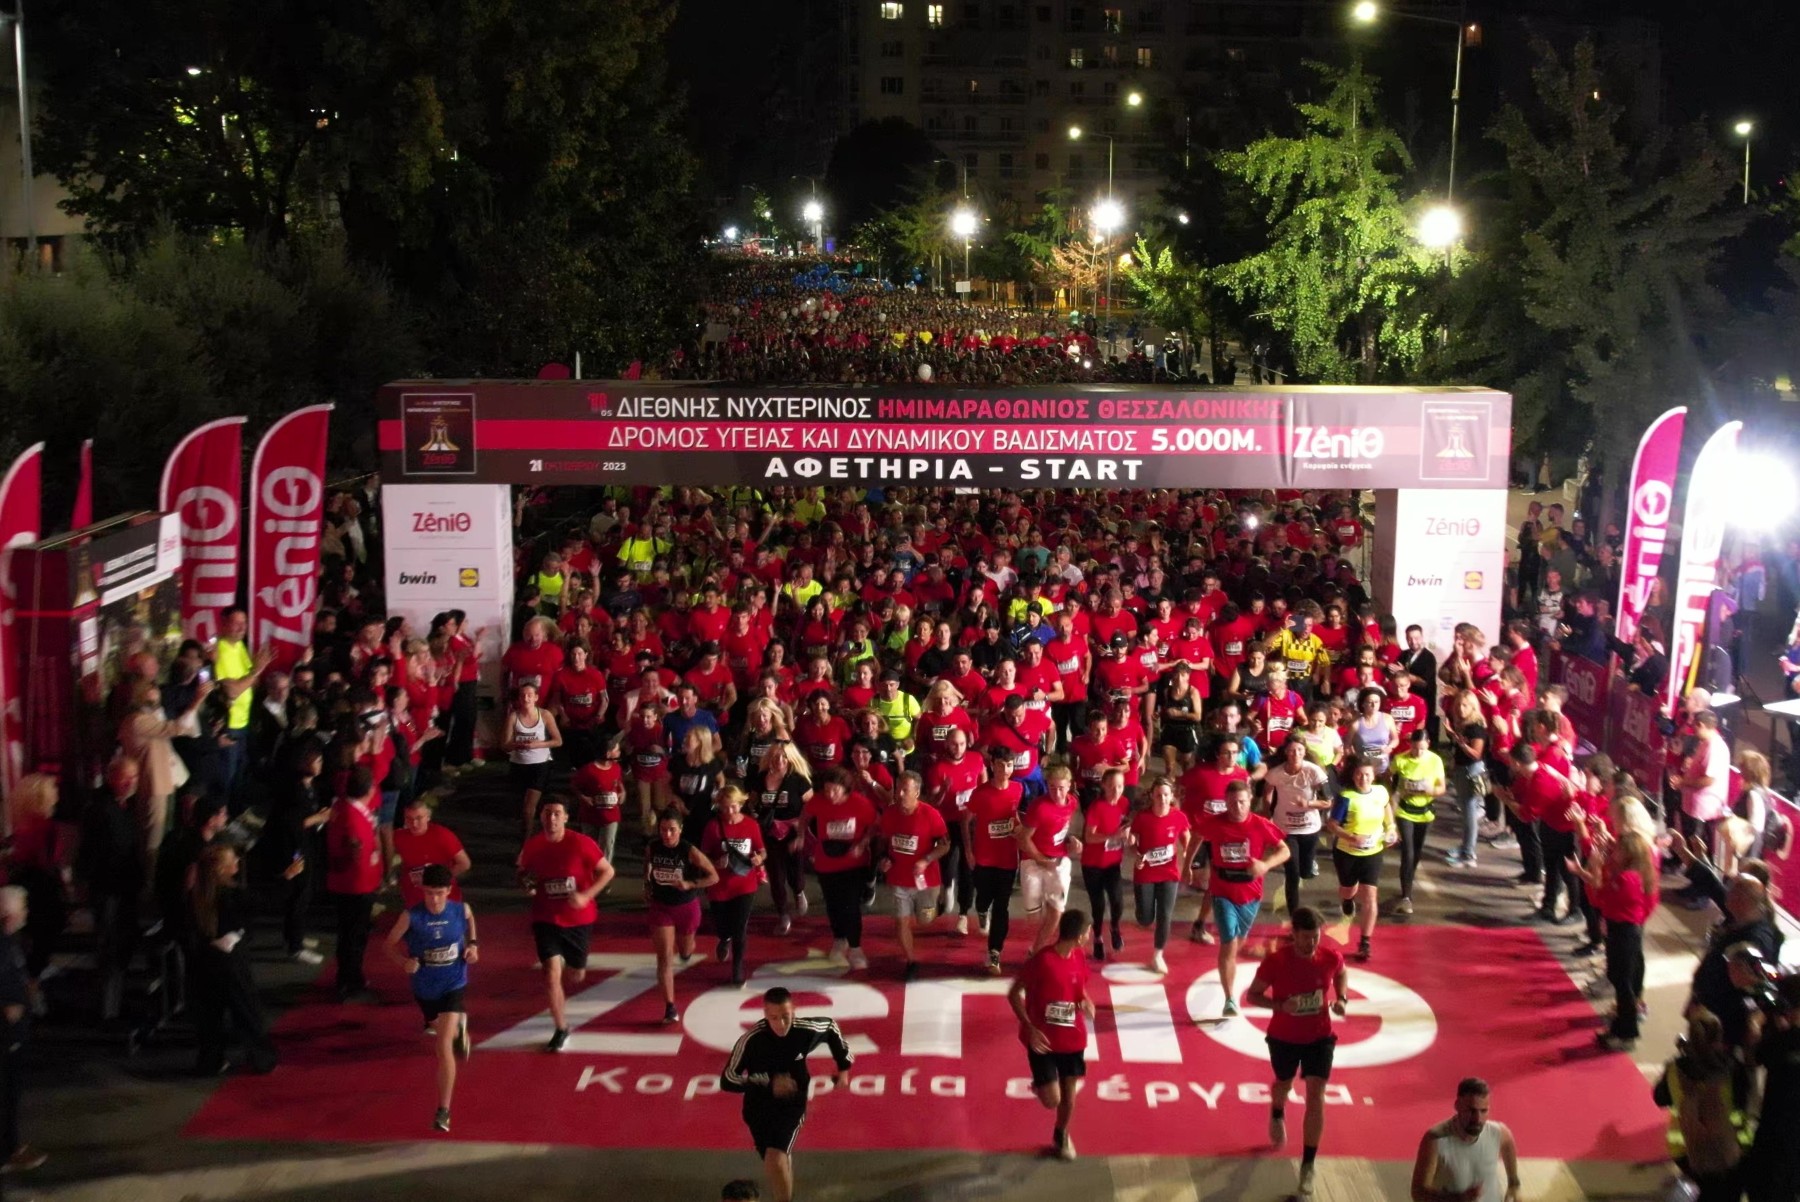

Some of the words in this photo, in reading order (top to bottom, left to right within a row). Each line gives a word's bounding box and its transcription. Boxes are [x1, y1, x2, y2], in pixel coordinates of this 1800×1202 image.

[616, 397, 720, 418] ΔΙΕΘΝΗΣ
[727, 397, 871, 418] ΝΥΧΤΕΡΙΝΟΣ
[878, 399, 1089, 419] ΗΜΙΜΑΡΑΘΩΝΙΟΣ
[1098, 399, 1284, 419] ΘΕΣΣΑΛΟΝΙΚΗΣ
[608, 426, 709, 448] ΔΡΟΜΟΣ
[716, 427, 794, 448] ΥΓΕΙΑΣ
[802, 428, 838, 449] ΚΑΙ
[847, 428, 985, 450] ΔΥΝΑΜΙΚΟΥ
[993, 429, 1137, 451] ΒΑΔΙΣΜΑΤΟΣ
[1151, 428, 1262, 452] 5.000Μ.
[602, 462, 627, 471] 2023
[764, 457, 973, 480] ΑΦΕΤΗΡΙΑ
[1020, 458, 1143, 481] START
[398, 571, 437, 585] bwin
[1407, 574, 1443, 586] bwin
[575, 1065, 966, 1101] Κοραία
